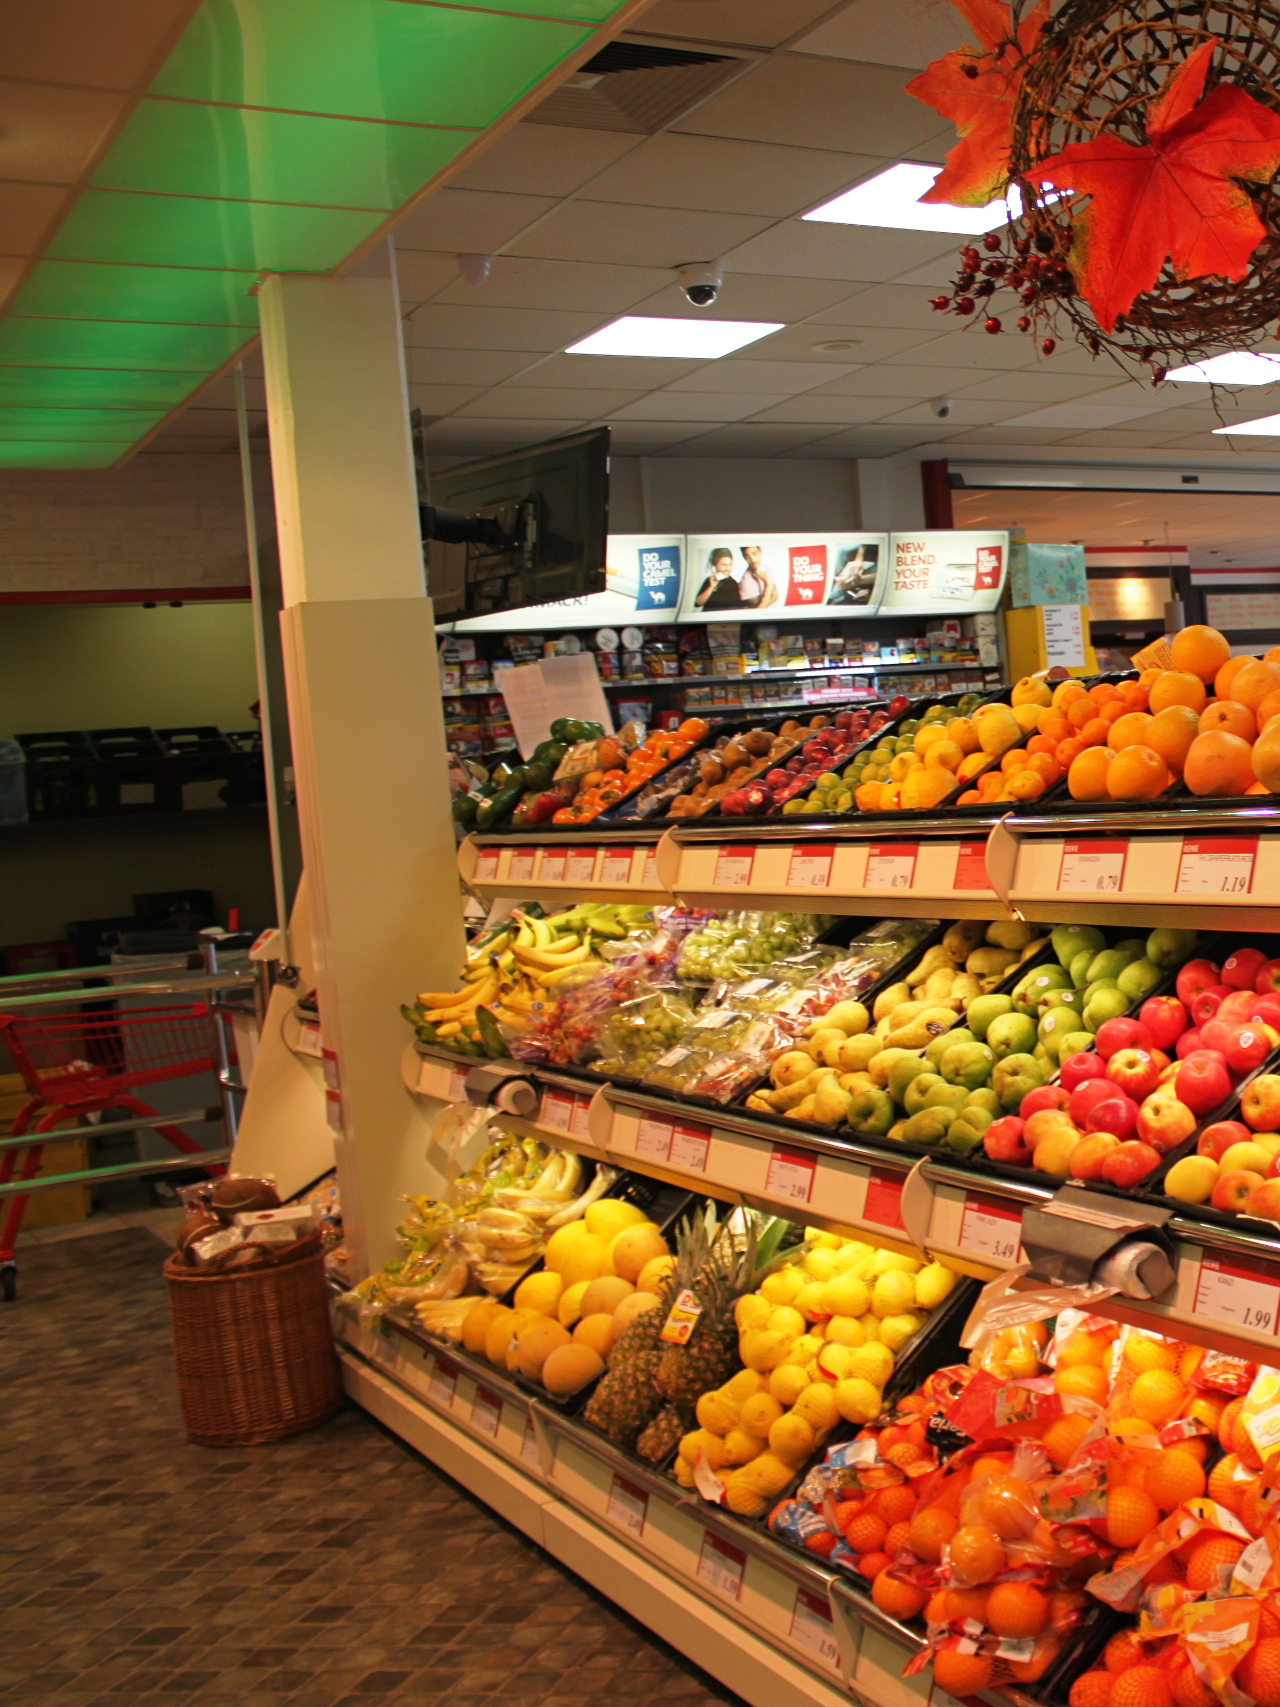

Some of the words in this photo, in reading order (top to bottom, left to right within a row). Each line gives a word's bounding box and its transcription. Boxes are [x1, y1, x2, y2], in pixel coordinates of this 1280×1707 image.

[896, 542, 926, 553] NEW
[642, 553, 659, 563] DO
[793, 556, 810, 565] DO
[896, 555, 938, 567] BLEND.
[643, 560, 671, 571] YOUR
[793, 563, 821, 575] YOUR
[642, 568, 677, 579] CAMEL
[792, 572, 824, 583] THING
[895, 568, 930, 579] YOUR
[643, 577, 666, 587] TEST
[894, 579, 932, 590] TASTE.
[1183, 844, 1199, 853] REWE
[1096, 875, 1119, 890] 0.79
[1220, 876, 1247, 892] 1.19
[1242, 1307, 1271, 1329] 1.99
